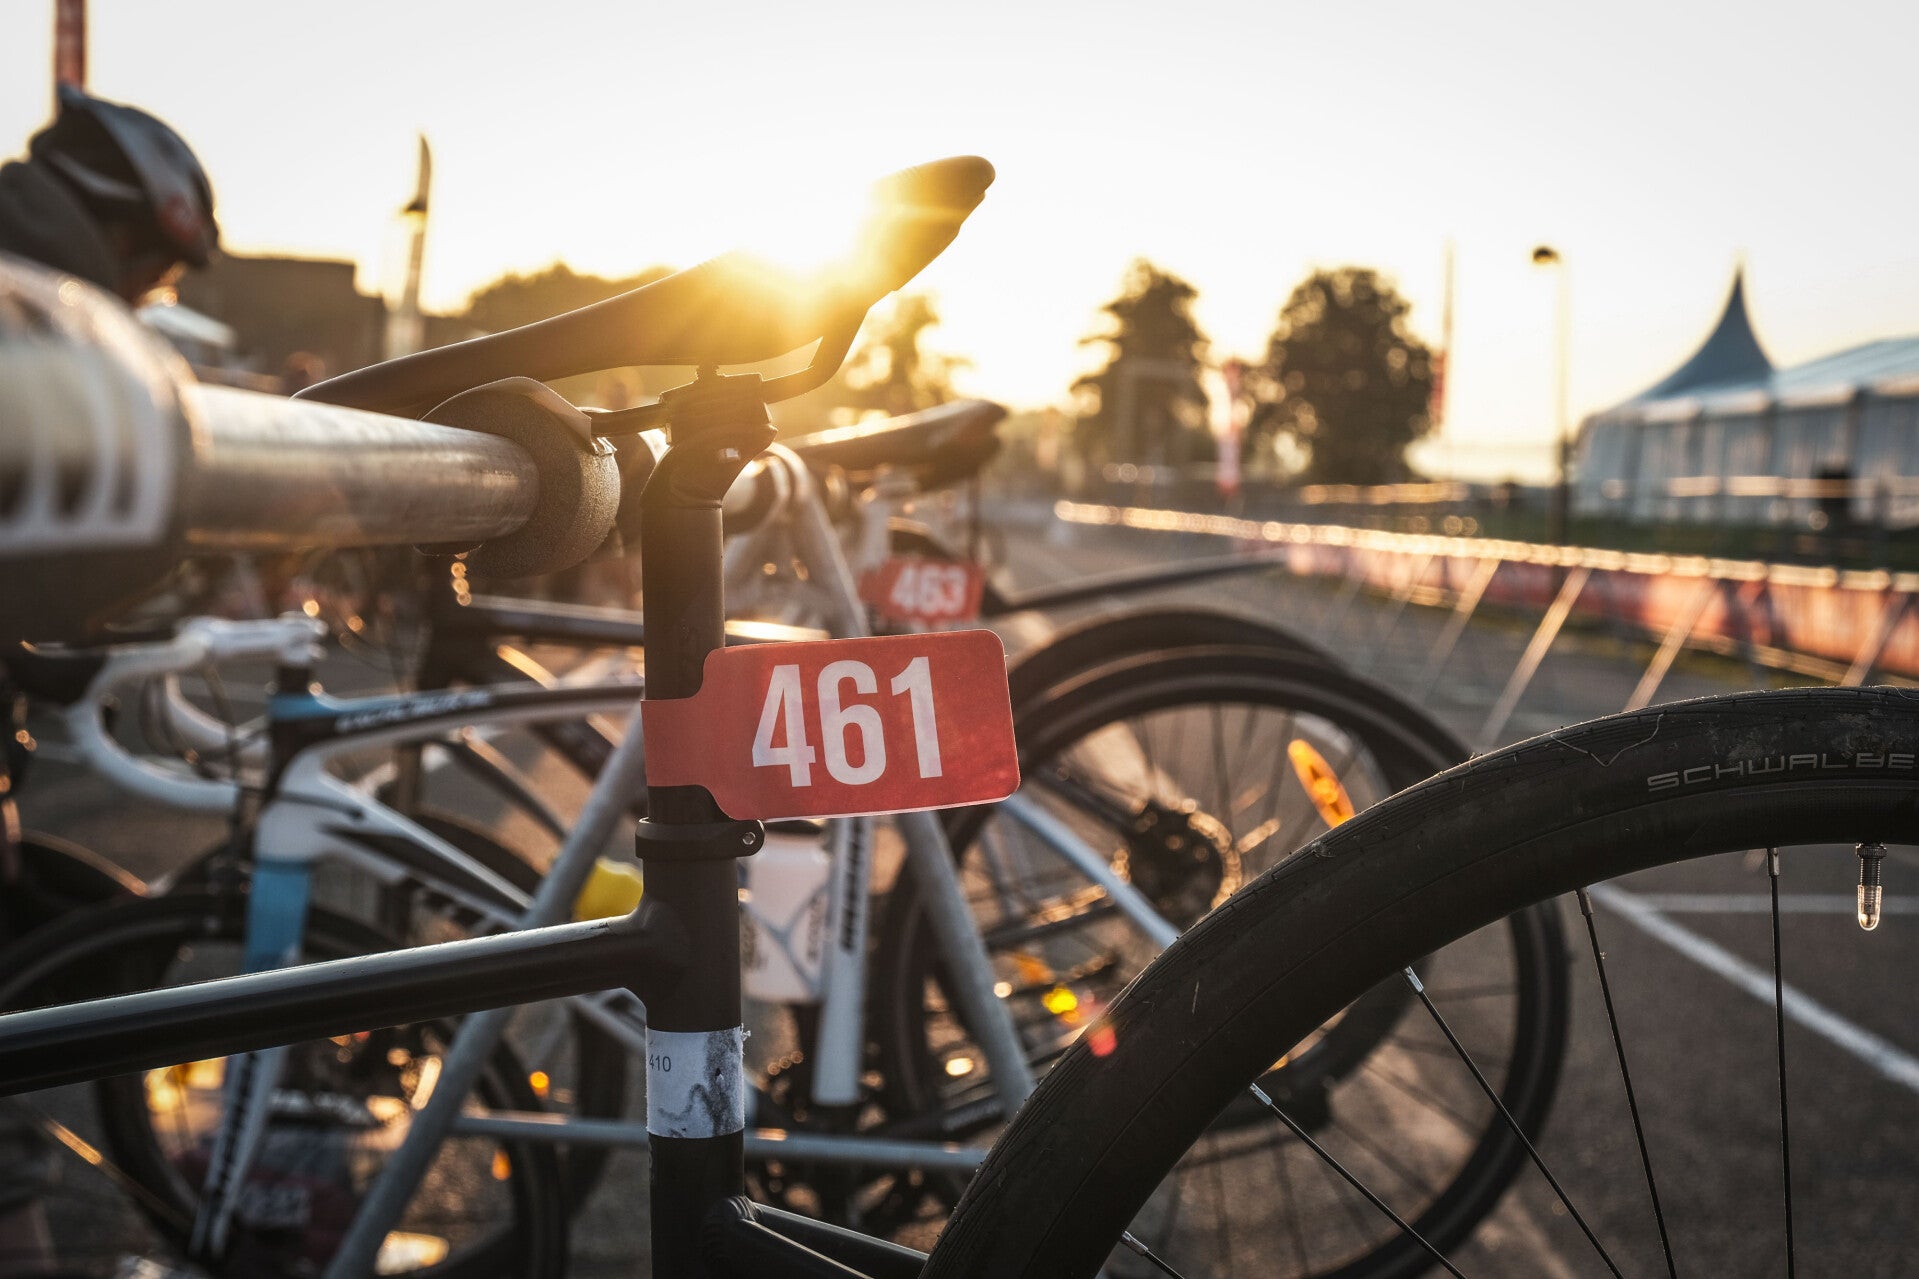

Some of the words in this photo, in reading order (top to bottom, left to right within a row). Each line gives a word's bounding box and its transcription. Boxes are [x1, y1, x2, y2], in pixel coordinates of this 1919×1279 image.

[890, 565, 968, 615] 463
[752, 656, 943, 787] 461
[1647, 753, 1915, 792] SCHWALBE
[649, 1054, 671, 1072] 410
